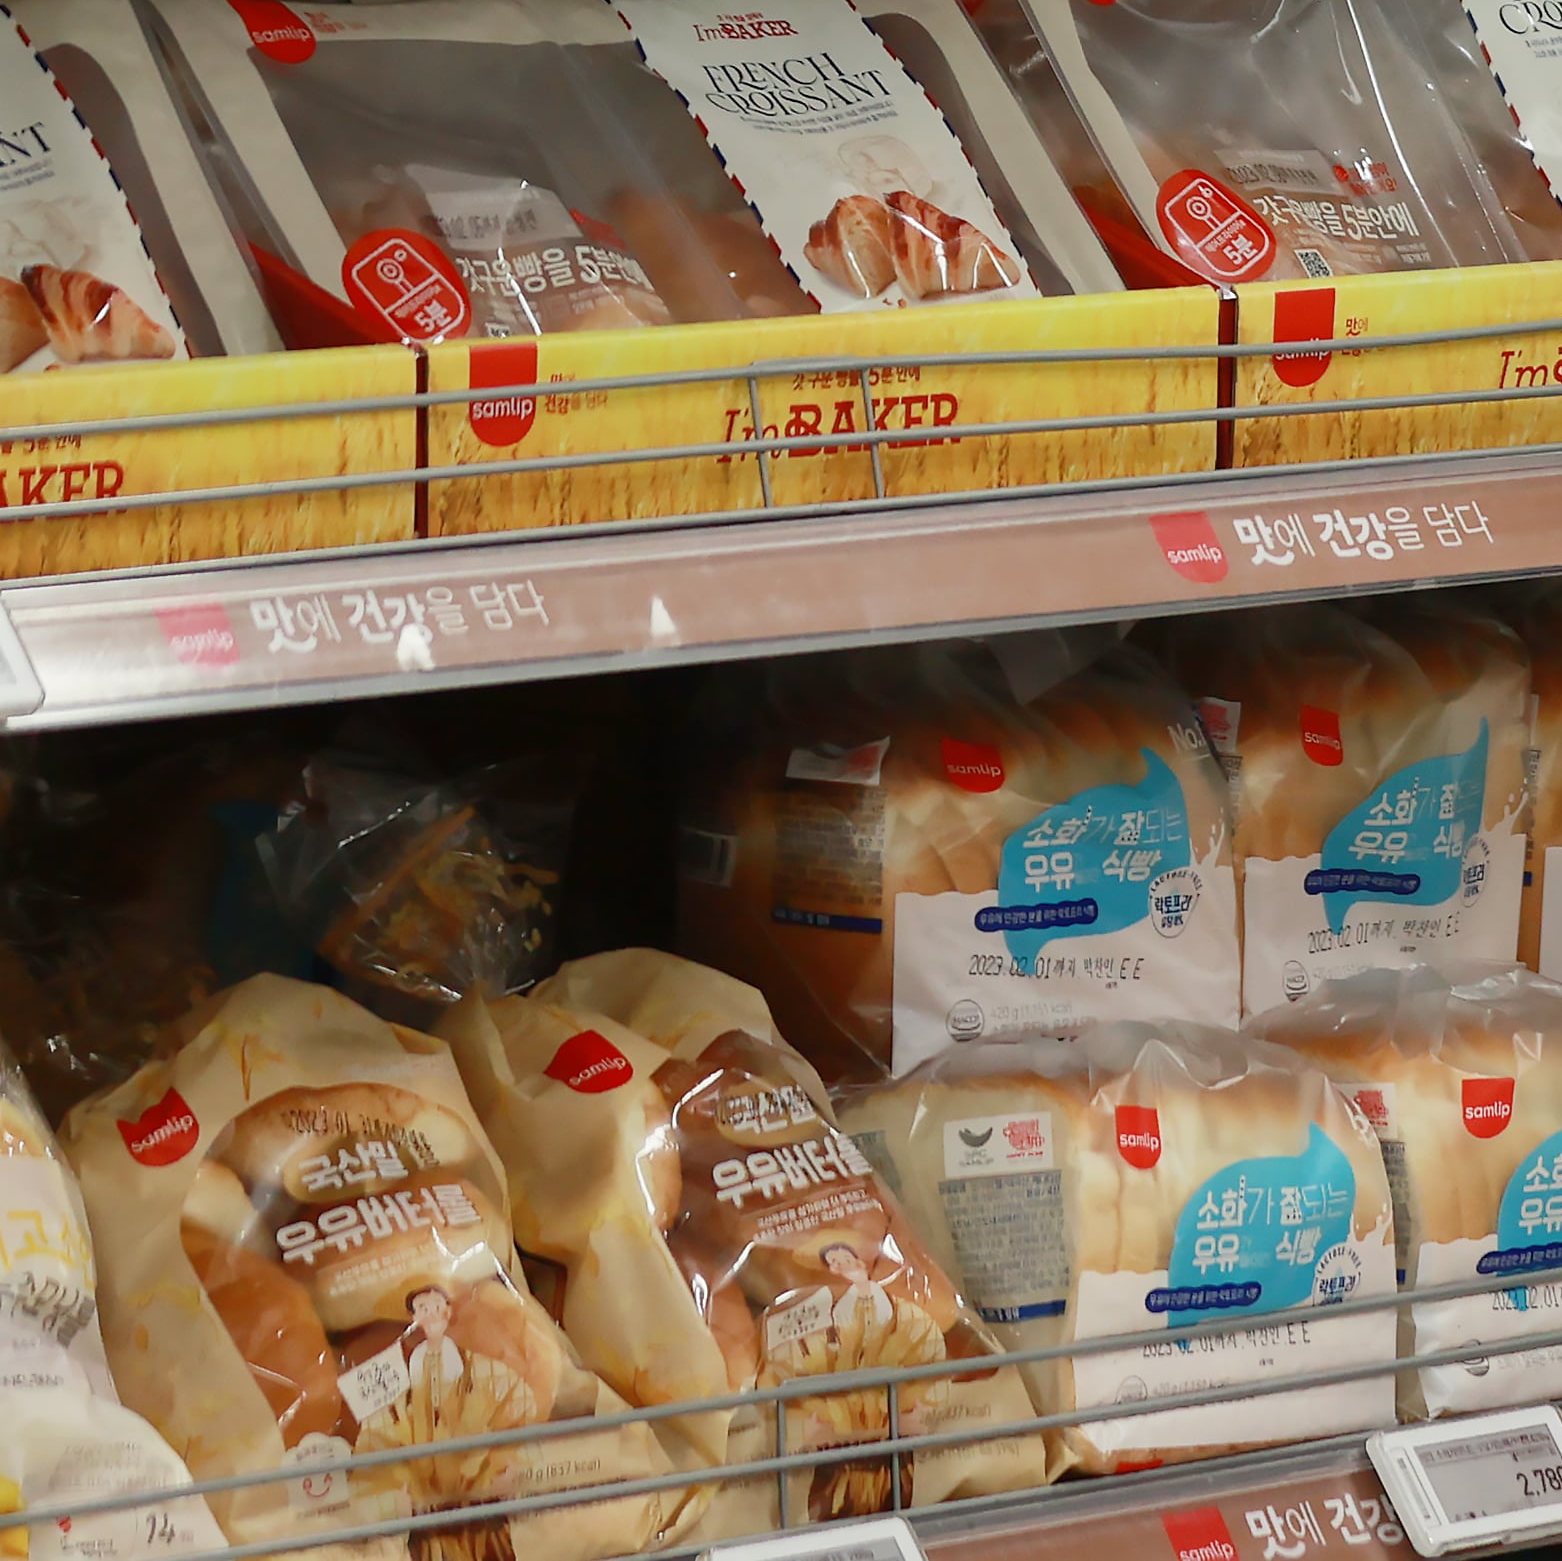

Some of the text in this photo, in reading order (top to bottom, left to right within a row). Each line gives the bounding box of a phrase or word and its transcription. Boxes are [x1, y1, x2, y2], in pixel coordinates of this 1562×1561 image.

[252, 23, 312, 46] samlip
[718, 19, 800, 40] BAKER
[702, 51, 846, 94] FRENCH
[704, 69, 892, 117] CROISSANT
[1222, 234, 1258, 266] 5분
[472, 396, 534, 421] samlip
[784, 391, 962, 459] BAKER
[1166, 542, 1223, 565] samlip
[1232, 499, 1494, 567] 맛에 건강을 담다
[249, 579, 549, 655] 맛에 건강을 담다
[947, 761, 1001, 778] samlip
[1022, 804, 1116, 848] 소화가
[1348, 830, 1409, 864] 우유
[1023, 849, 1162, 894] 우유 식빵
[1153, 892, 1194, 914] 락토프리
[568, 1050, 627, 1086] samlip
[1465, 1100, 1511, 1120] samlip
[130, 1112, 196, 1156] samlip
[1119, 1131, 1160, 1151] samlip
[299, 1139, 409, 1193] 국산밀
[711, 1133, 874, 1210] 우유버터롤
[1196, 1173, 1349, 1231] 소화가 잘되는
[275, 1183, 482, 1266] 우유버터롤
[1192, 1226, 1322, 1275] 우유 식빵
[1244, 1500, 1328, 1559] 맛에
